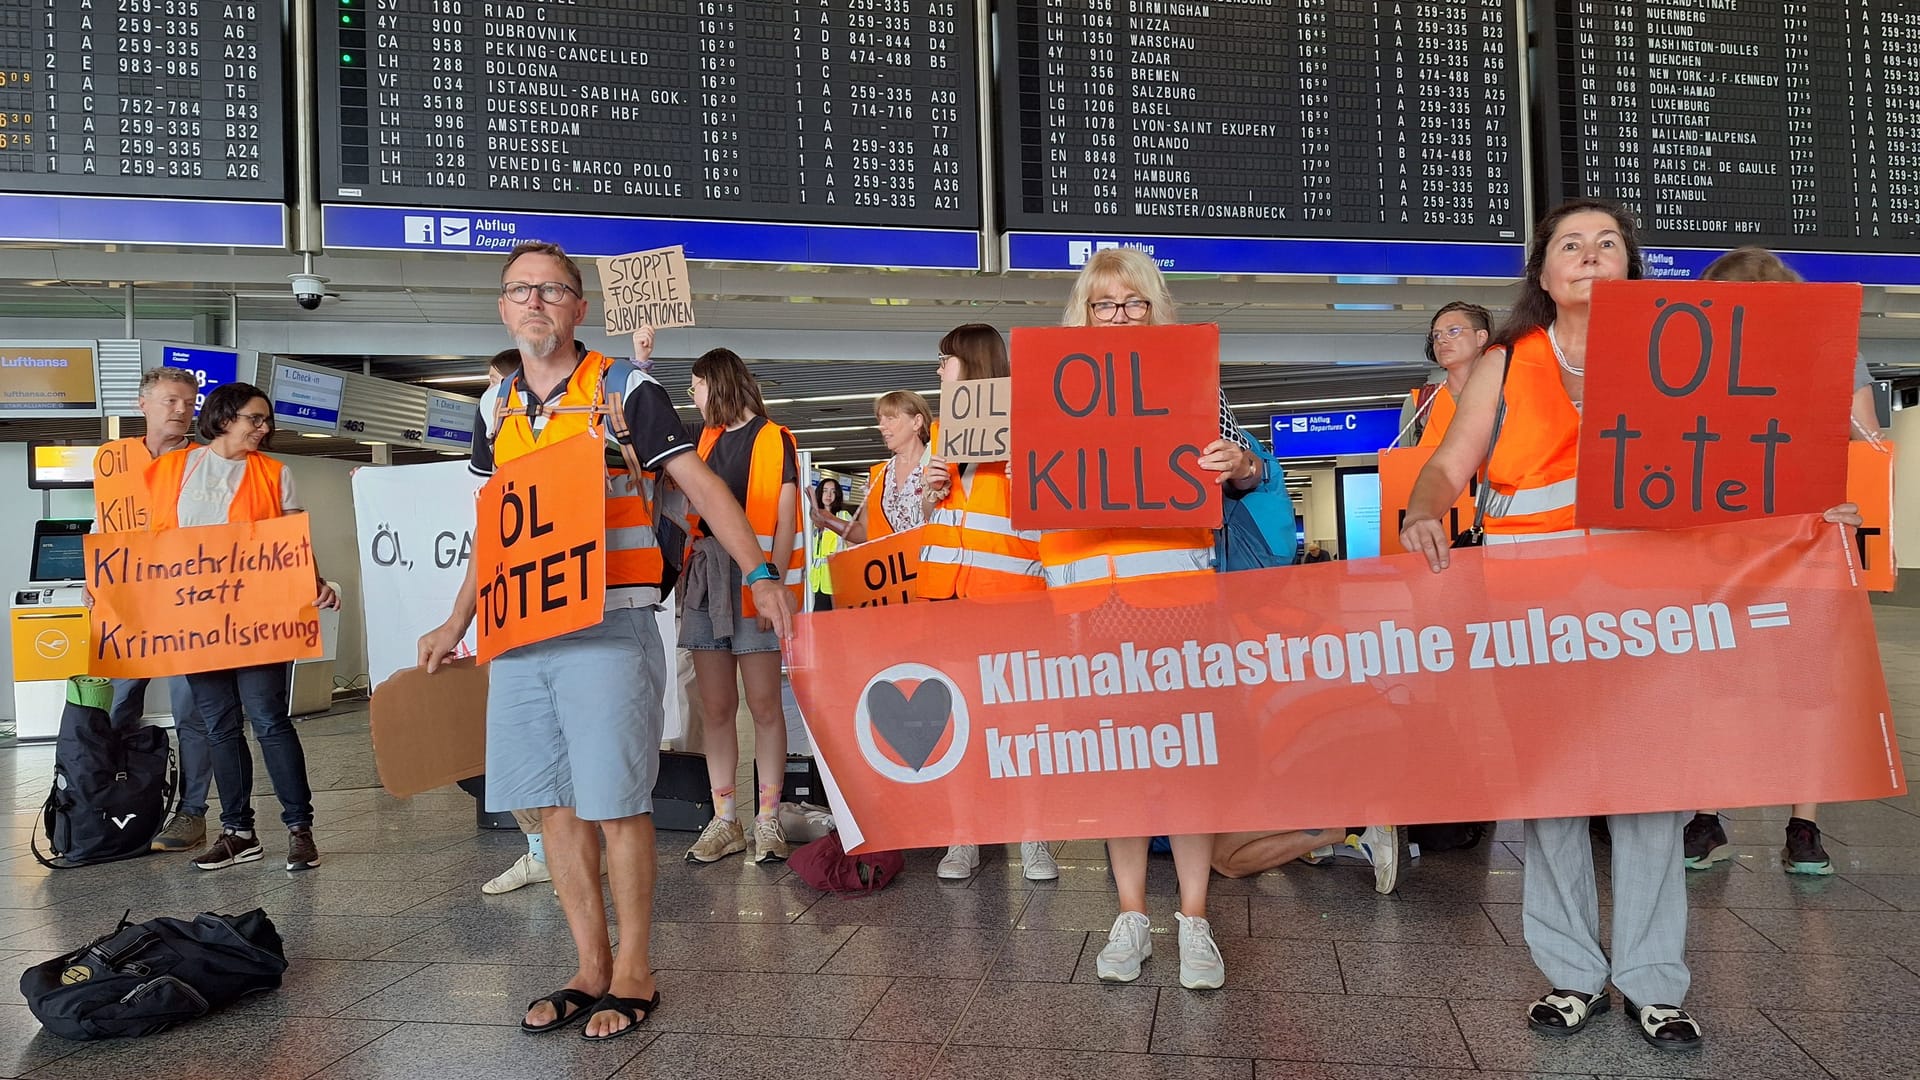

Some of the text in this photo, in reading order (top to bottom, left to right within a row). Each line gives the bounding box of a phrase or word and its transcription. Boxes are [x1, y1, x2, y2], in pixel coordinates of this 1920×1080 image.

[223, 4, 255, 20] A18
[1129, 0, 1209, 17] BIRMINGHAM
[1614, 5, 1633, 17] 148
[1646, 7, 1706, 23] NUERNBERG
[118, 17, 245, 39] 259-335 A6
[433, 0, 946, 51] 180 RIAD C 841-844 D4
[1129, 17, 1170, 31] NIZZA
[1614, 20, 1693, 37] 840 BILLUND
[118, 37, 256, 59] 259-335 A23
[432, 18, 946, 68] 900 DUBROVNIK 474-488 B5
[432, 37, 648, 65] 958 PEKING-CANCELLED
[1130, 34, 1194, 50] WARSCHAU
[1614, 35, 1758, 56] 933 WASHINGTON-DULLES
[119, 57, 257, 79] 983-985 D16
[1131, 50, 1170, 65] ZADAR
[1648, 53, 1701, 67] MUENCHEN
[433, 57, 956, 104] 288 BOLOGNA 259-335 A30
[1131, 67, 1179, 82] BREMEN
[1649, 67, 1779, 86] NEW YORK-J.F.KENNEDY
[225, 83, 246, 98] T5
[433, 76, 957, 122] 034 ISTANBUL-SABIHA GOK. 714-716 C15
[1132, 84, 1505, 116] SALZBURG A17
[1649, 82, 1715, 97] DOHA-HAMAD
[120, 98, 258, 119] 752-784 B43
[1132, 101, 1171, 115] BASEL
[1610, 95, 1710, 112] 8754 LUXEMBURG
[423, 94, 948, 138] 3518 DUESSELDORF HBF T7
[1651, 113, 1710, 127] LTUTTGART
[120, 118, 258, 139] 259-335 B32
[434, 114, 949, 156] 996 AMSTERDAM 259-335 A8
[1133, 118, 1507, 147] LYON-SAINT EXUPERY B13
[1652, 128, 1757, 144] MAILAND-MALPENSA
[121, 139, 259, 158] 259-335 A24
[425, 133, 958, 174] 1016 BRUESSEL 259-335 A13
[1133, 135, 1507, 163] ORLANDO C17
[1134, 152, 1173, 166] TURIN
[1652, 143, 1712, 156] AMSTERDAM
[121, 159, 259, 178] 259-335 A26
[435, 152, 959, 192] 328 VENEDIG-MARCO POLO 259-335 A36
[1614, 156, 1776, 175] 1046 PARIS CH. DE GAULLE
[426, 171, 958, 209] 1040 PARIS CH. DE GAULLE 259-335 A21
[1134, 169, 1509, 194] HAMBURG B23
[1654, 173, 1713, 186] BARCELONA
[1135, 186, 1509, 210] HANNOVER A19
[1615, 187, 1707, 201] 1304 ISTANBUL
[1135, 202, 1503, 225] MUENSTER/OSNABRUECK A9
[1655, 203, 1682, 215] WIEN
[475, 219, 516, 234] Abflug
[1656, 218, 1760, 232] DUESSELDORF HBFV
[609, 251, 675, 285] STOPPT
[1648, 254, 1674, 266] Abflug
[608, 277, 679, 306] FOSSILE
[606, 302, 693, 332] SUBVENTIONEN
[1648, 297, 1777, 397] ÖL
[1, 356, 69, 368] Lufthansa
[1053, 352, 1169, 418] OIL
[951, 383, 1007, 420] OIL
[343, 420, 365, 433] 463
[1309, 414, 1357, 430] Abflug C
[1310, 424, 1344, 432] Departures
[403, 430, 422, 441] 462
[943, 427, 1009, 458] KILLS
[99, 444, 129, 477] Oil
[1600, 413, 1791, 514] tötet
[1028, 444, 1207, 511] KILLS
[100, 495, 148, 533] Kills
[499, 480, 554, 548] ÖL
[371, 521, 414, 571] ÖL,
[864, 551, 918, 591] OIL
[175, 578, 246, 606] statt
[480, 540, 596, 637] TÖTET
[98, 613, 319, 660] Kriminalisierung
[979, 601, 1791, 705] Klimakatastrophe zulassen =
[985, 711, 1218, 779] kriminell
